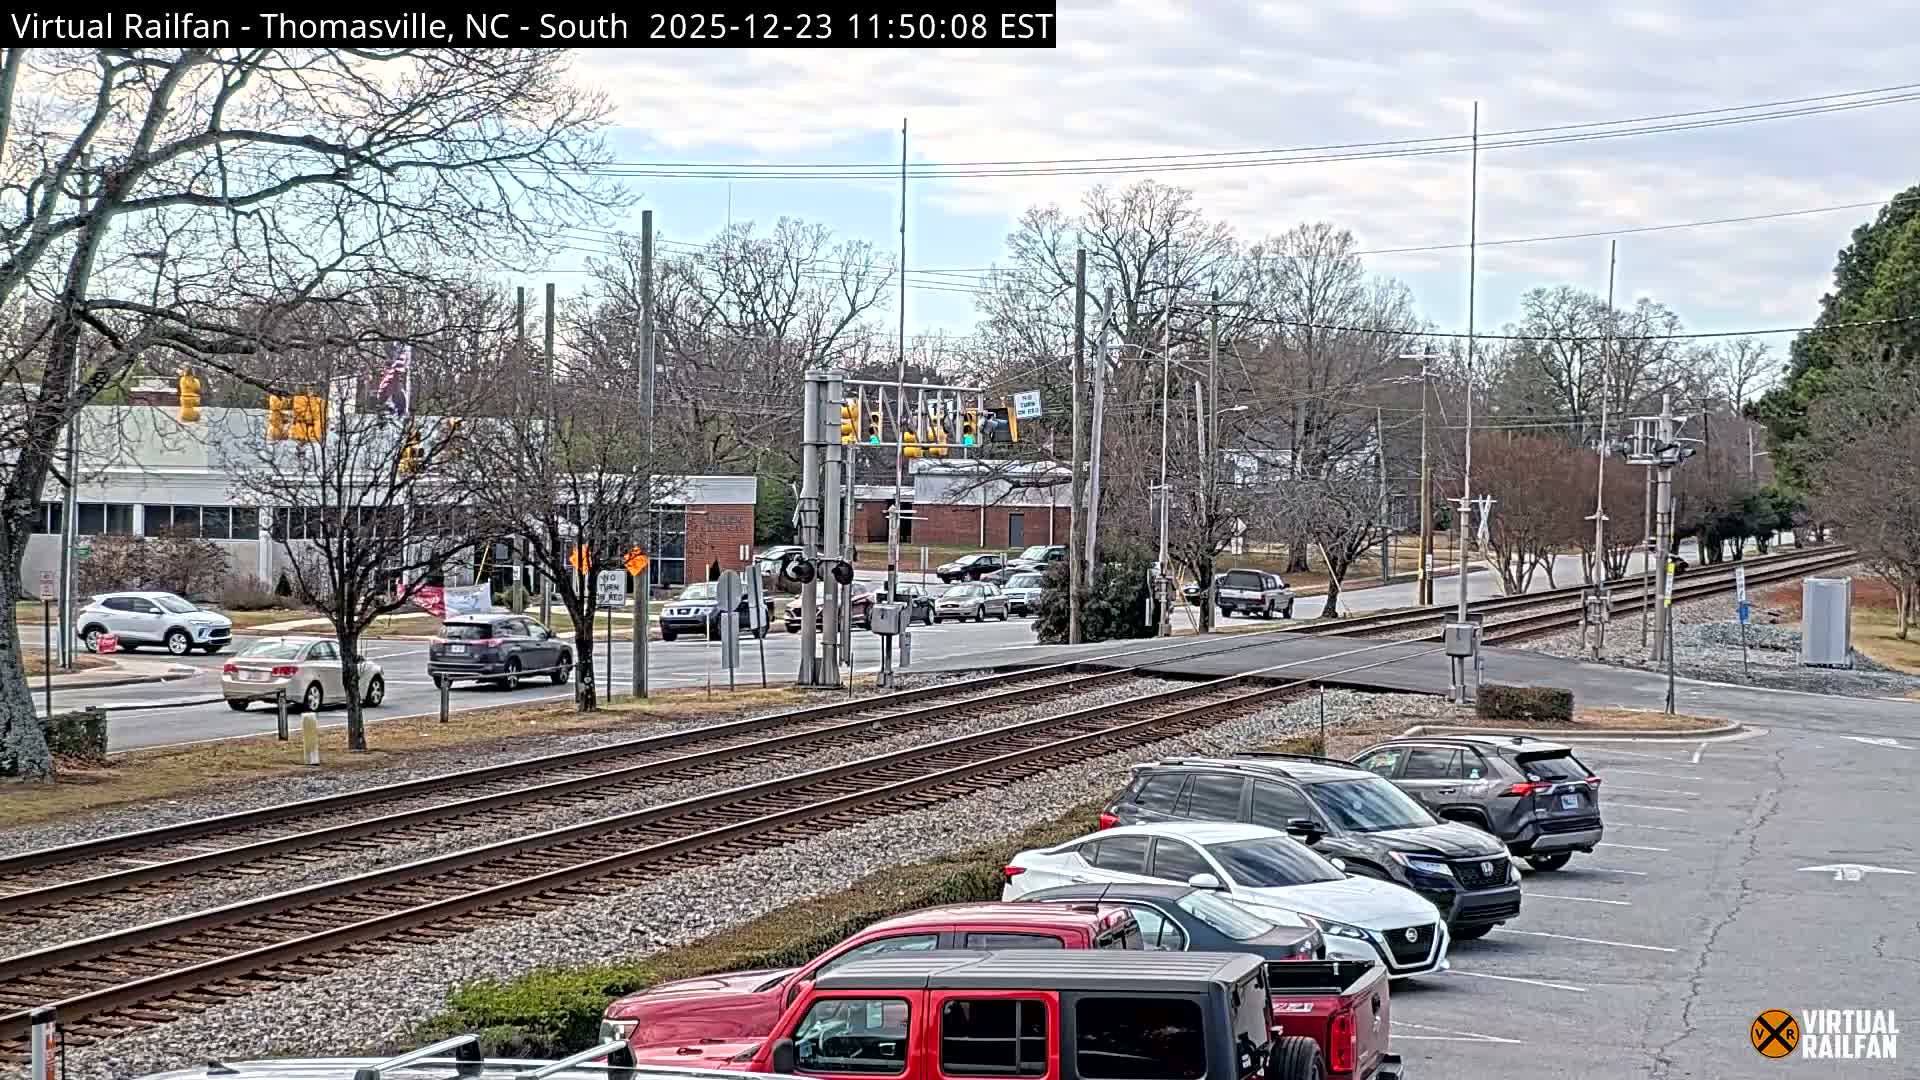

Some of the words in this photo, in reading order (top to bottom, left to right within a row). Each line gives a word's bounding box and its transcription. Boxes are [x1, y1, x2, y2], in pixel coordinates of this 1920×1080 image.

[599, 574, 616, 582] NO
[599, 583, 619, 592] TURN
[608, 593, 623, 601] RED
